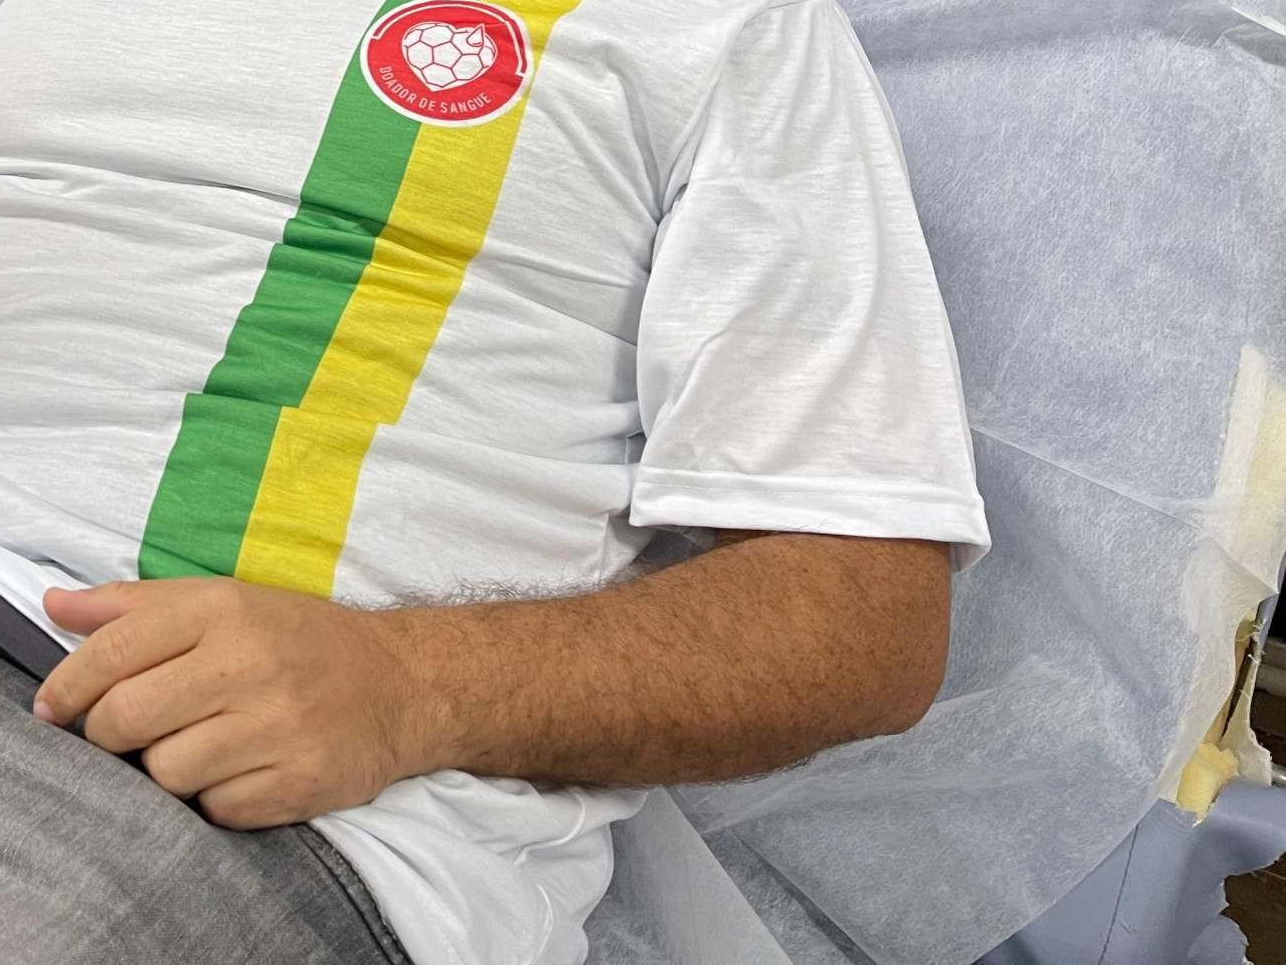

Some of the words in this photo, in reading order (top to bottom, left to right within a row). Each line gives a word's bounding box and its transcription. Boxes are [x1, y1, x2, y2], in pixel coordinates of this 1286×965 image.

[380, 67, 416, 104] DOADOR
[419, 98, 436, 111] DE
[440, 93, 491, 114] SANGUE
